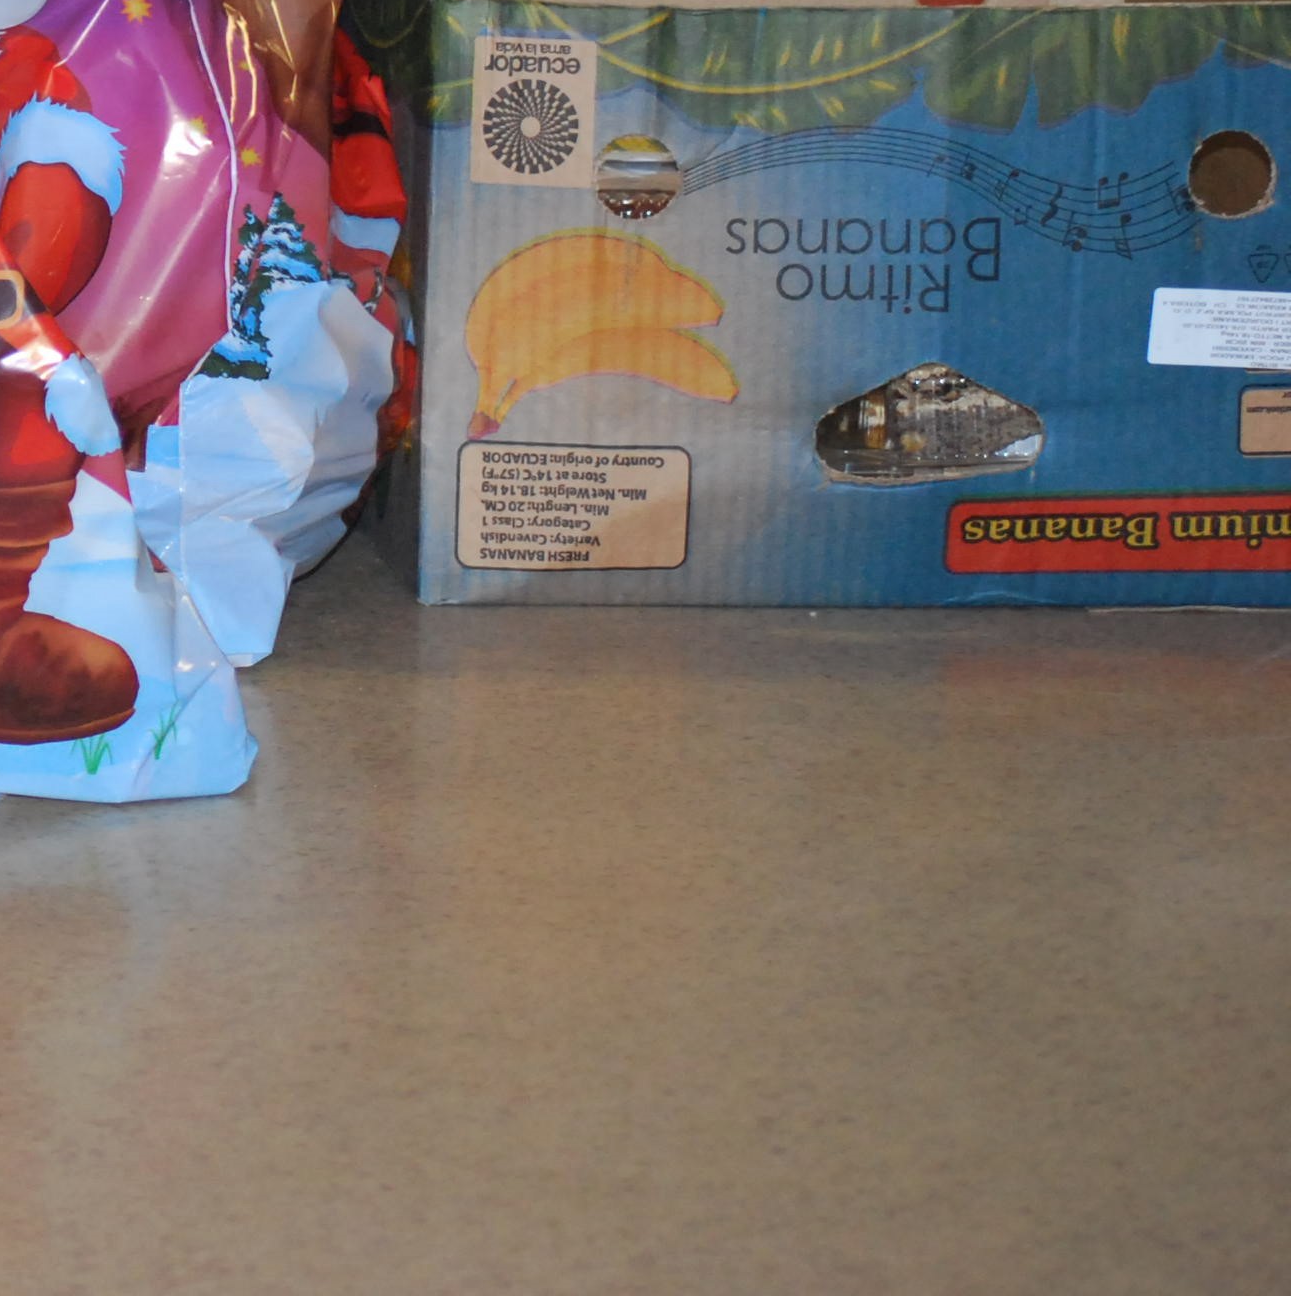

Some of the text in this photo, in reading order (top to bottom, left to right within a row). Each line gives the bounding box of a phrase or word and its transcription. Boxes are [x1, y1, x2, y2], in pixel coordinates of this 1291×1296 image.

[495, 41, 571, 56] ama la vida
[484, 54, 581, 77] ecuador
[726, 217, 1001, 282] Bananas
[776, 264, 951, 314] Ritmo
[482, 451, 665, 469] Country of origin: ECUADOR
[555, 470, 570, 481] at
[571, 471, 607, 484] Store
[481, 481, 647, 501] Min. Net Weight: 18.14 kg
[481, 499, 609, 516] Min. Length: 20 CM.
[482, 515, 591, 531] Category: Class 1
[962, 512, 1158, 549] Bananas
[480, 532, 601, 547] Variety: Cavendish
[479, 547, 590, 562] FRESH BANANAS
